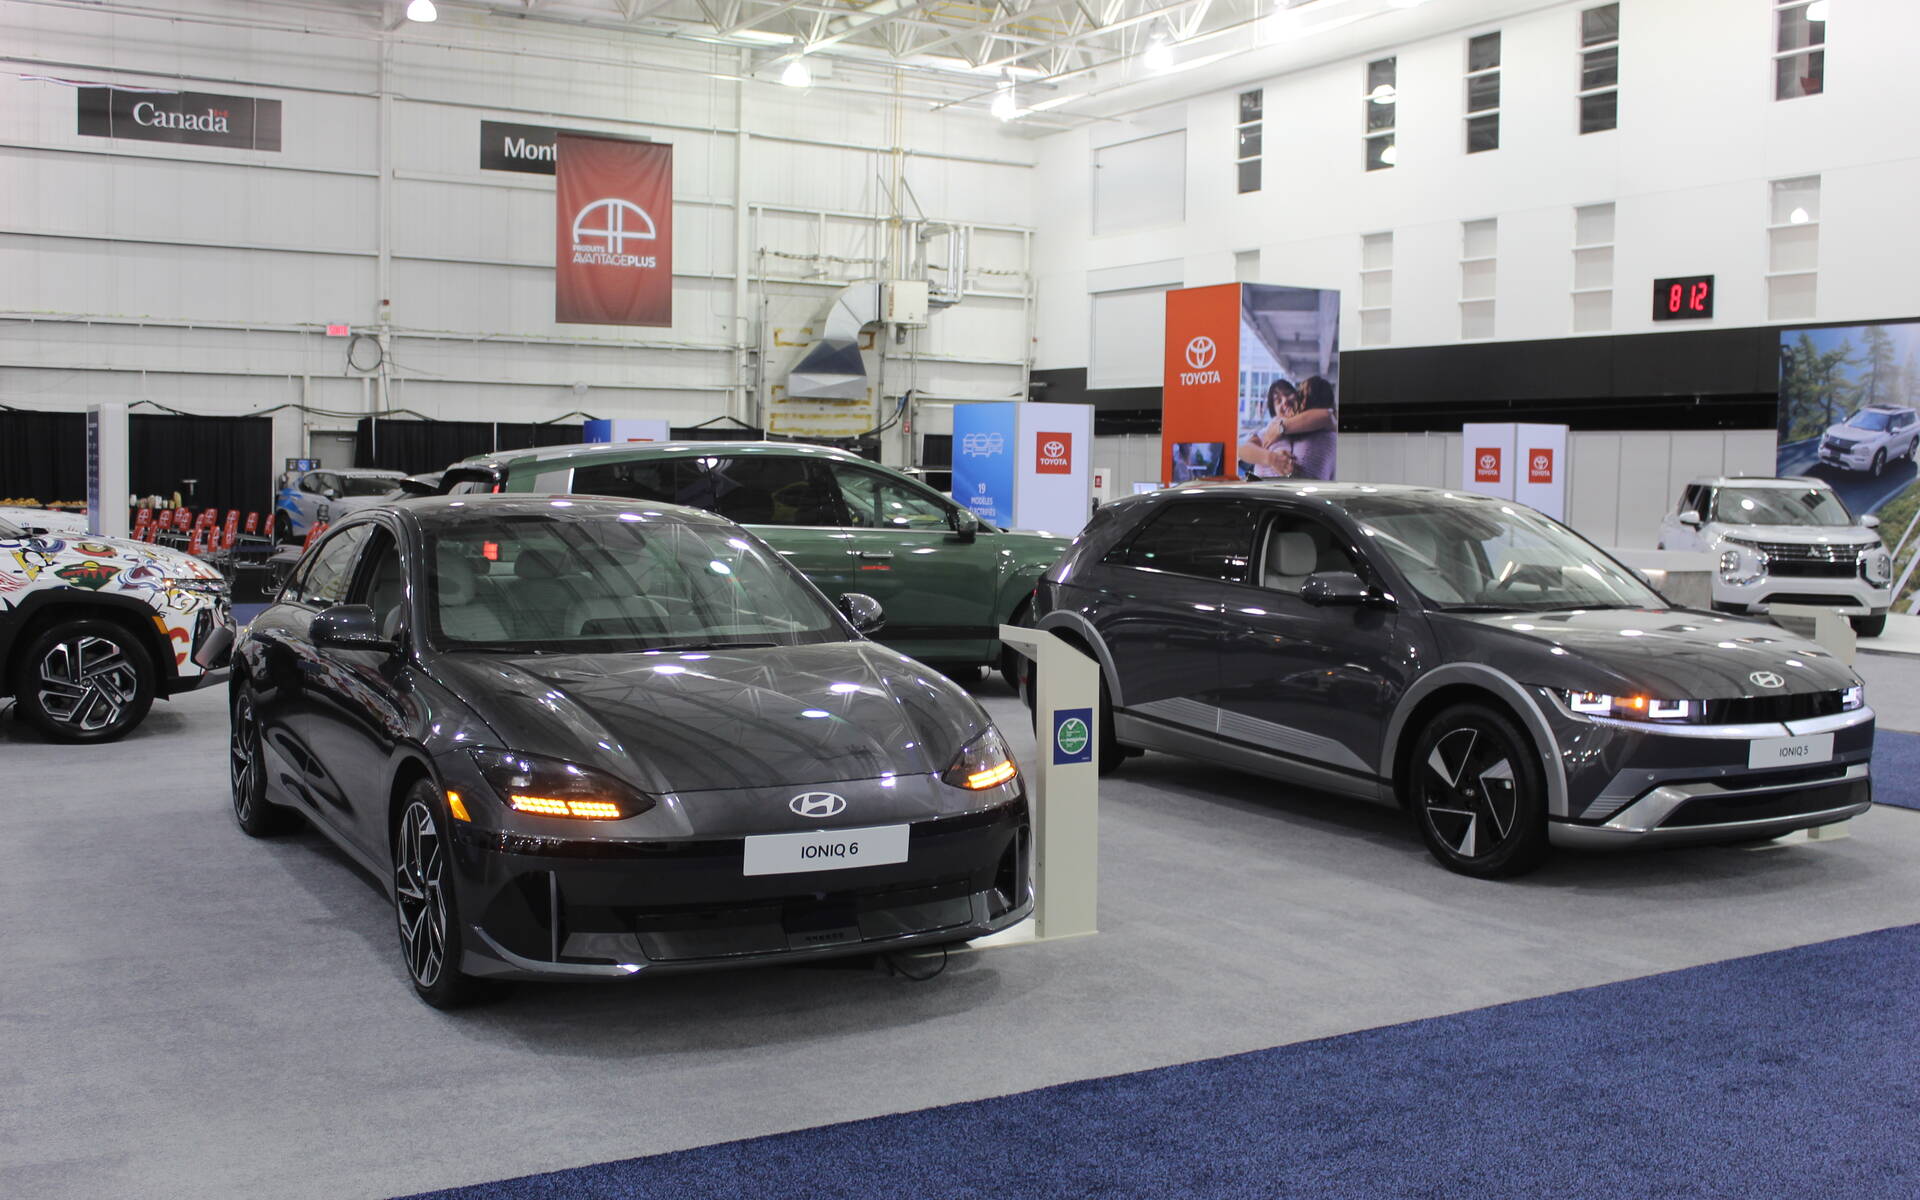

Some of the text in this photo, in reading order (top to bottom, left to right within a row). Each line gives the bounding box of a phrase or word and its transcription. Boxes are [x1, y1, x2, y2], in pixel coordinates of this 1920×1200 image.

[133, 101, 230, 133] Canada
[573, 252, 656, 268] AVANTAGEPLUS
[1180, 371, 1221, 386] TOYOTA
[1040, 458, 1067, 466] TOYOTA
[1779, 745, 1809, 757] IONIQ 5
[801, 842, 859, 859] IONIQ 6
